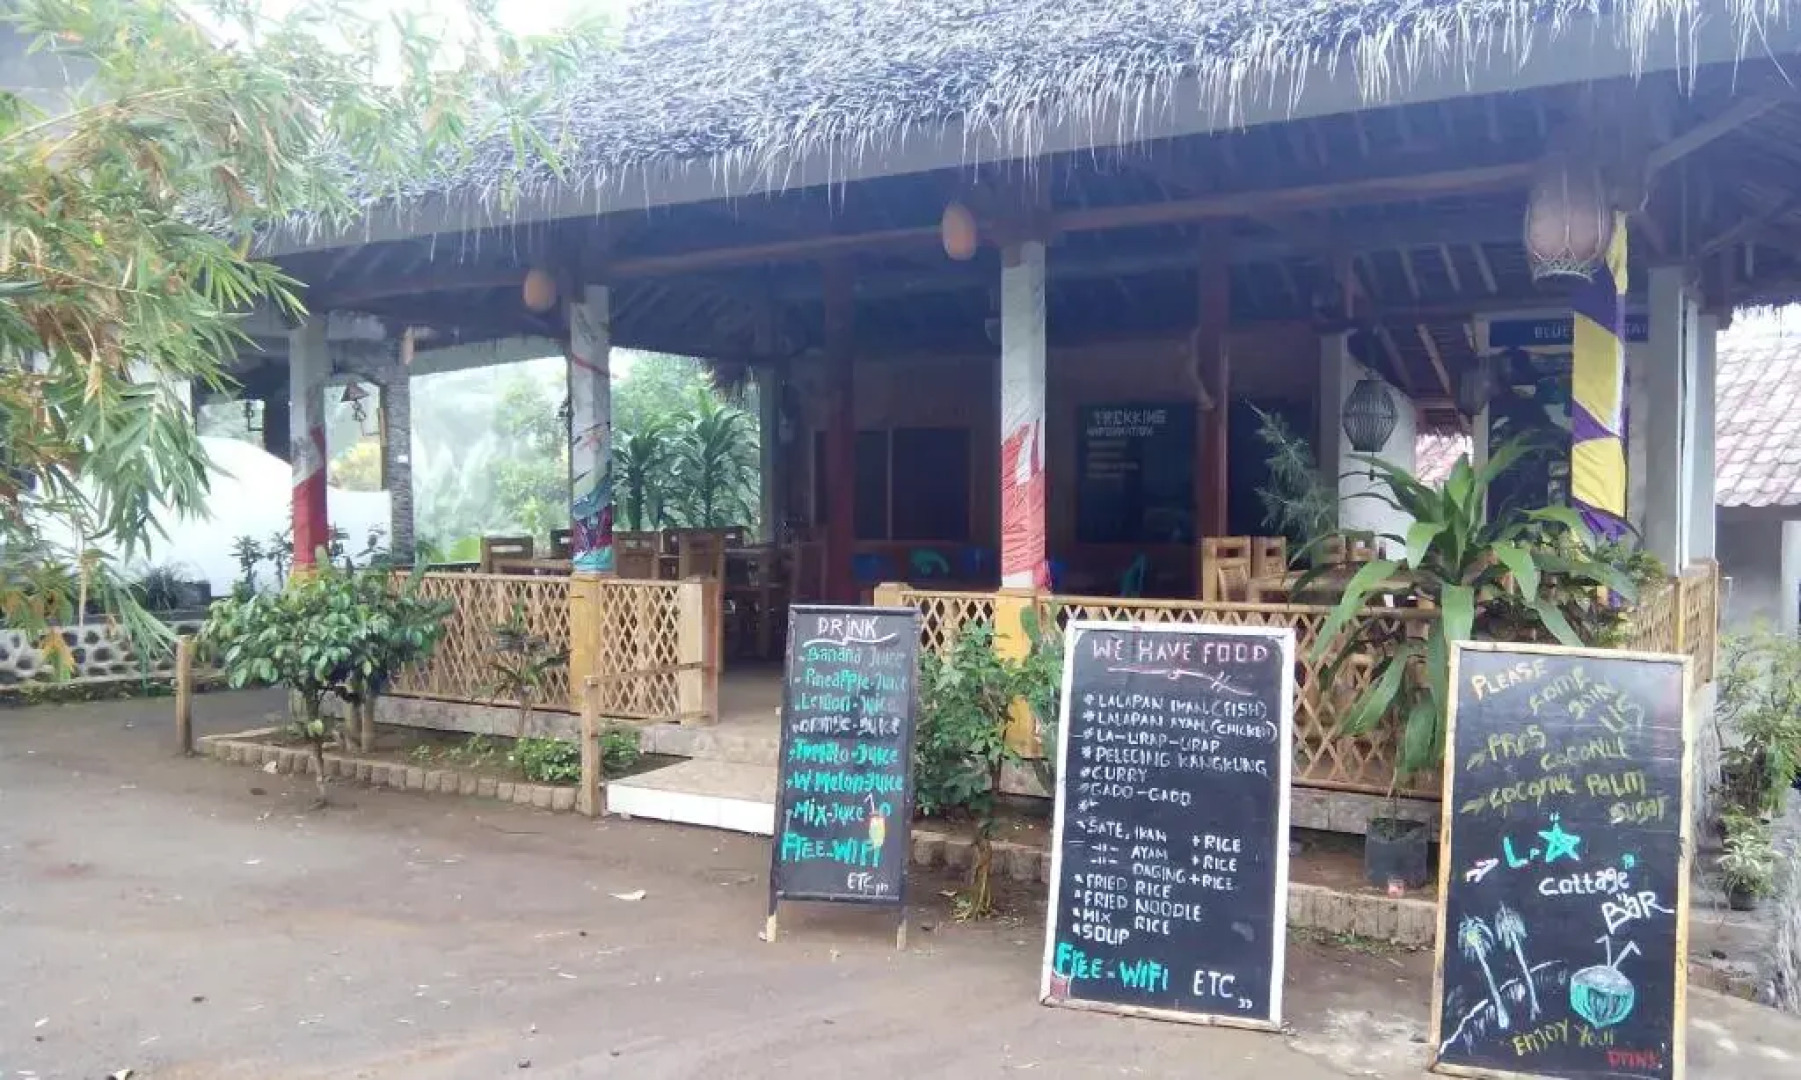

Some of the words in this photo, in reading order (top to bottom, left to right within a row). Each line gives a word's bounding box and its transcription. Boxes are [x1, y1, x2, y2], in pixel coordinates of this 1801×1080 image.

[1092, 638, 1125, 661] WE
[1139, 639, 1193, 663] HAVE
[1203, 642, 1268, 664] FOOD
[1098, 694, 1164, 710] LALAPAN
[1097, 712, 1164, 727] LALAPAN
[1091, 766, 1148, 783] CURRY
[1130, 845, 1169, 860] AYAM
[1131, 861, 1187, 884] DAGING
[1086, 873, 1128, 891] FRIED
[1135, 880, 1173, 899] RICE
[1084, 890, 1129, 910] FRIED
[1135, 898, 1202, 923] NOODLE
[1083, 908, 1112, 924] MIX
[1134, 916, 1171, 935] RICE
[1083, 924, 1131, 946] SOUP
